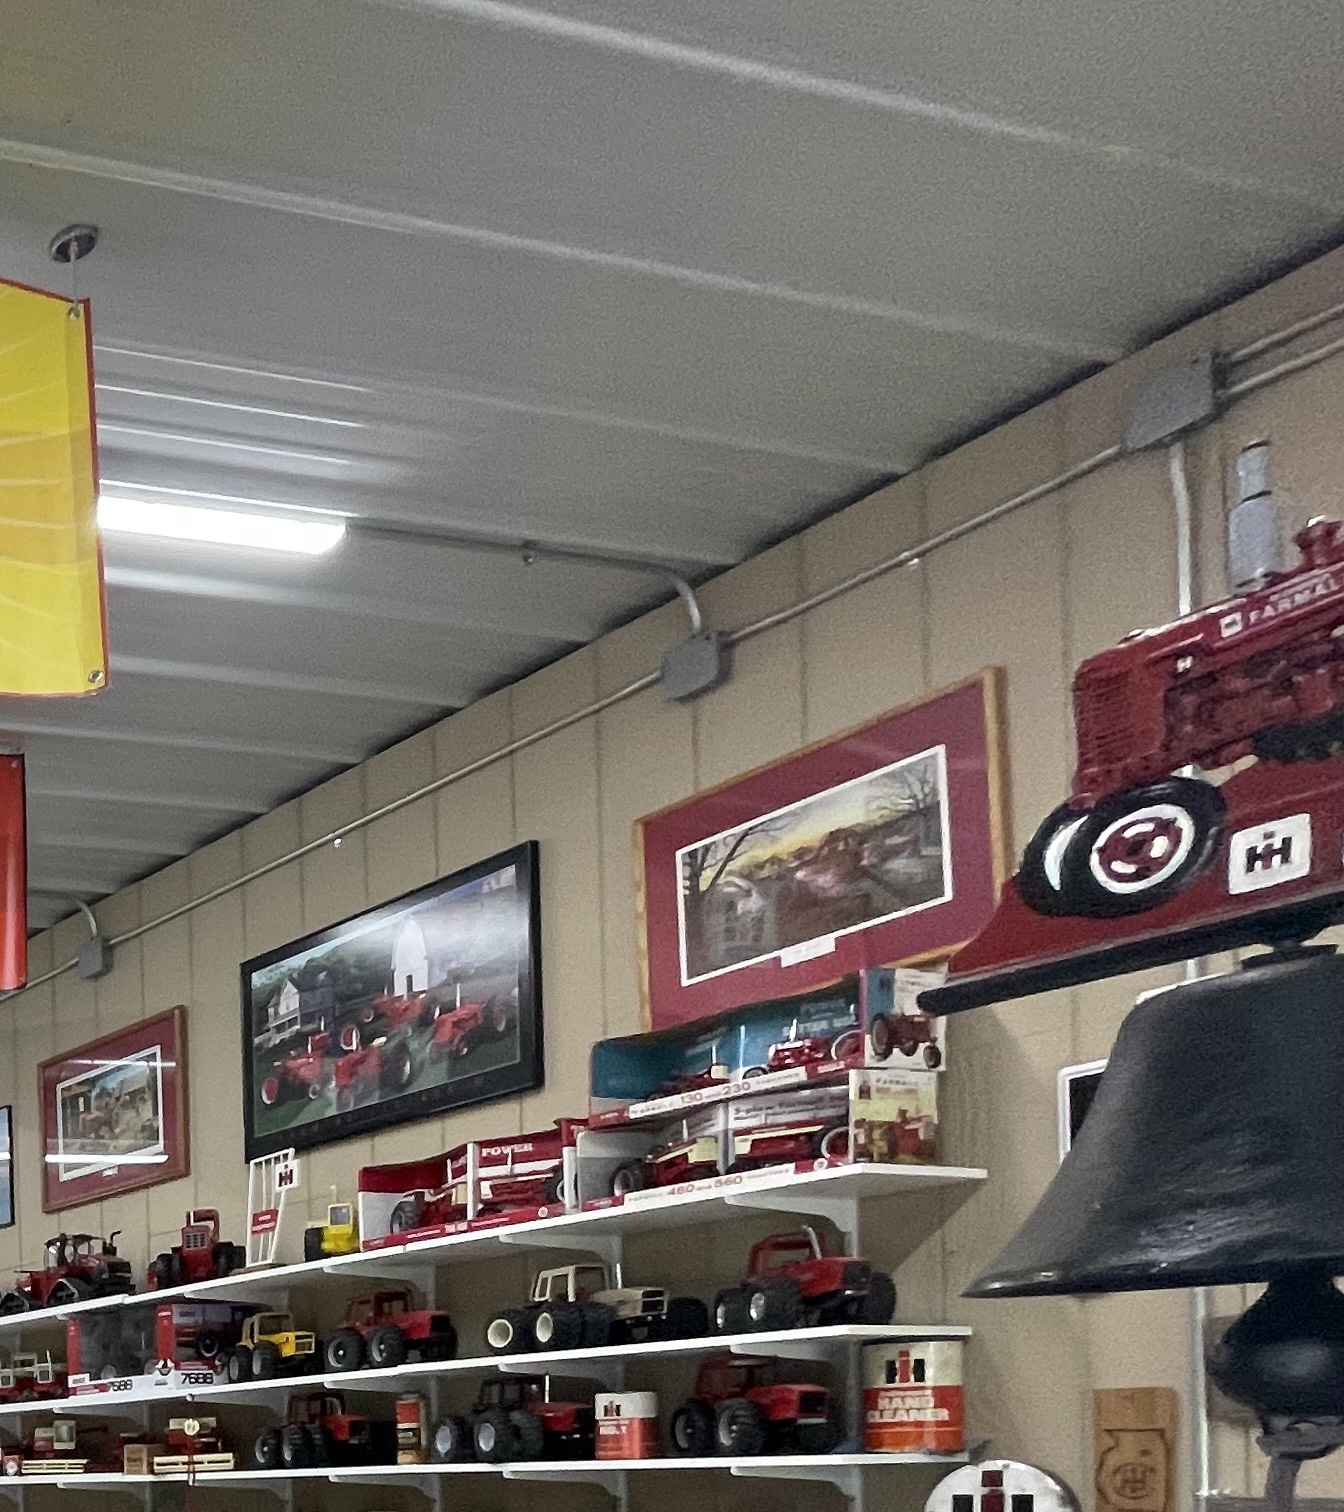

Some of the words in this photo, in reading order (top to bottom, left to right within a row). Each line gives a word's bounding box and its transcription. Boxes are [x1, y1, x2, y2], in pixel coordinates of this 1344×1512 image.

[722, 1081, 752, 1096] 230
[481, 1142, 533, 1157] POWER
[667, 1183, 696, 1197] 460
[181, 1372, 214, 1385] 7688
[877, 1396, 934, 1410] HAND
[867, 1408, 949, 1423] CLEANER
